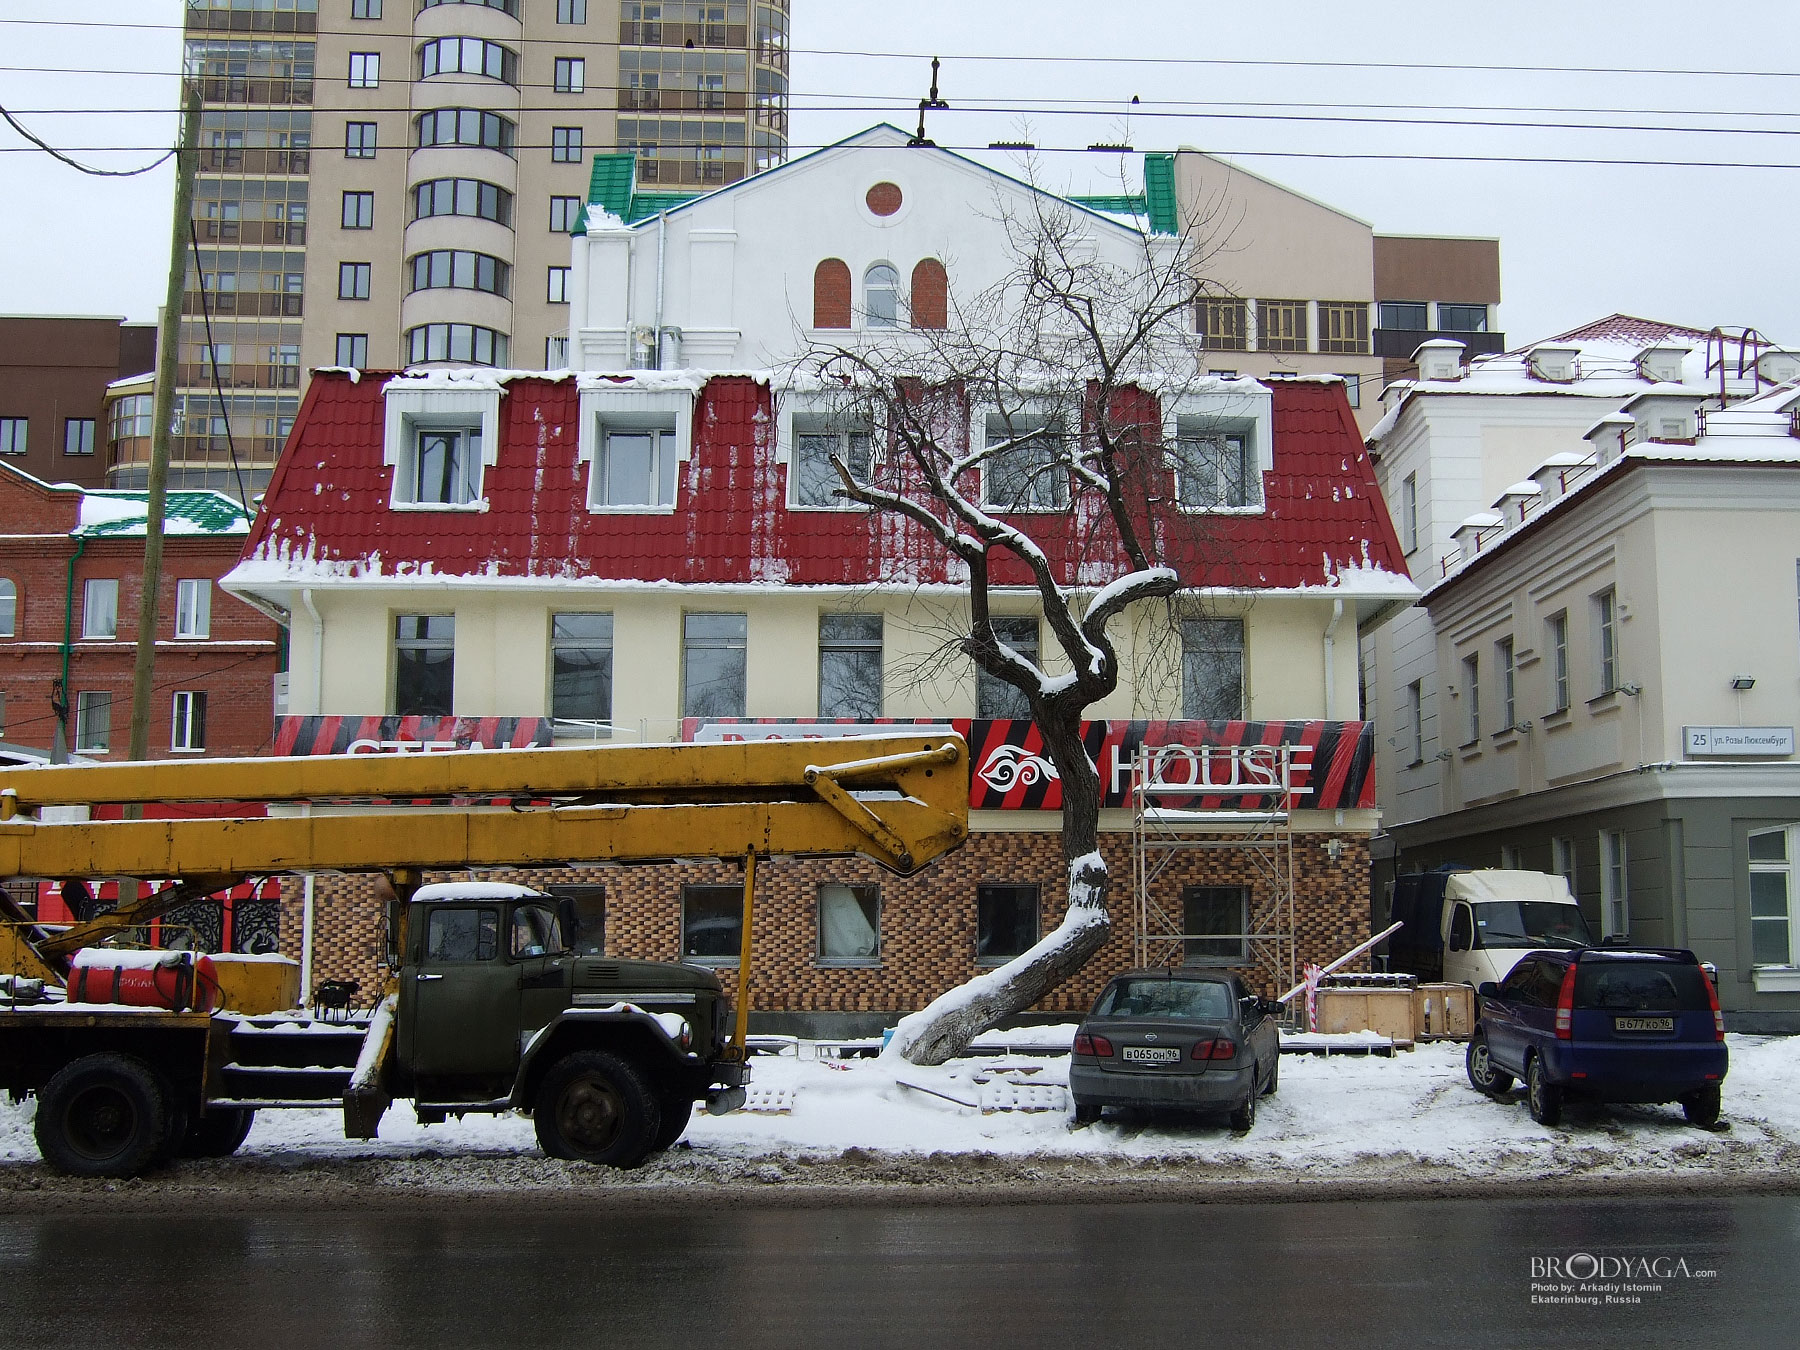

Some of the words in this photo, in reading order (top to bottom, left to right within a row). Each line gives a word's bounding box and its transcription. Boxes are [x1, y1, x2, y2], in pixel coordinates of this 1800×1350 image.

[1693, 734, 1707, 746] 25
[1714, 736, 1724, 746] ул.
[1725, 735, 1743, 745] Розы
[1744, 735, 1788, 747] Люксембург
[1111, 743, 1314, 794] HOUSE
[1167, 1050, 1177, 1058] 96
